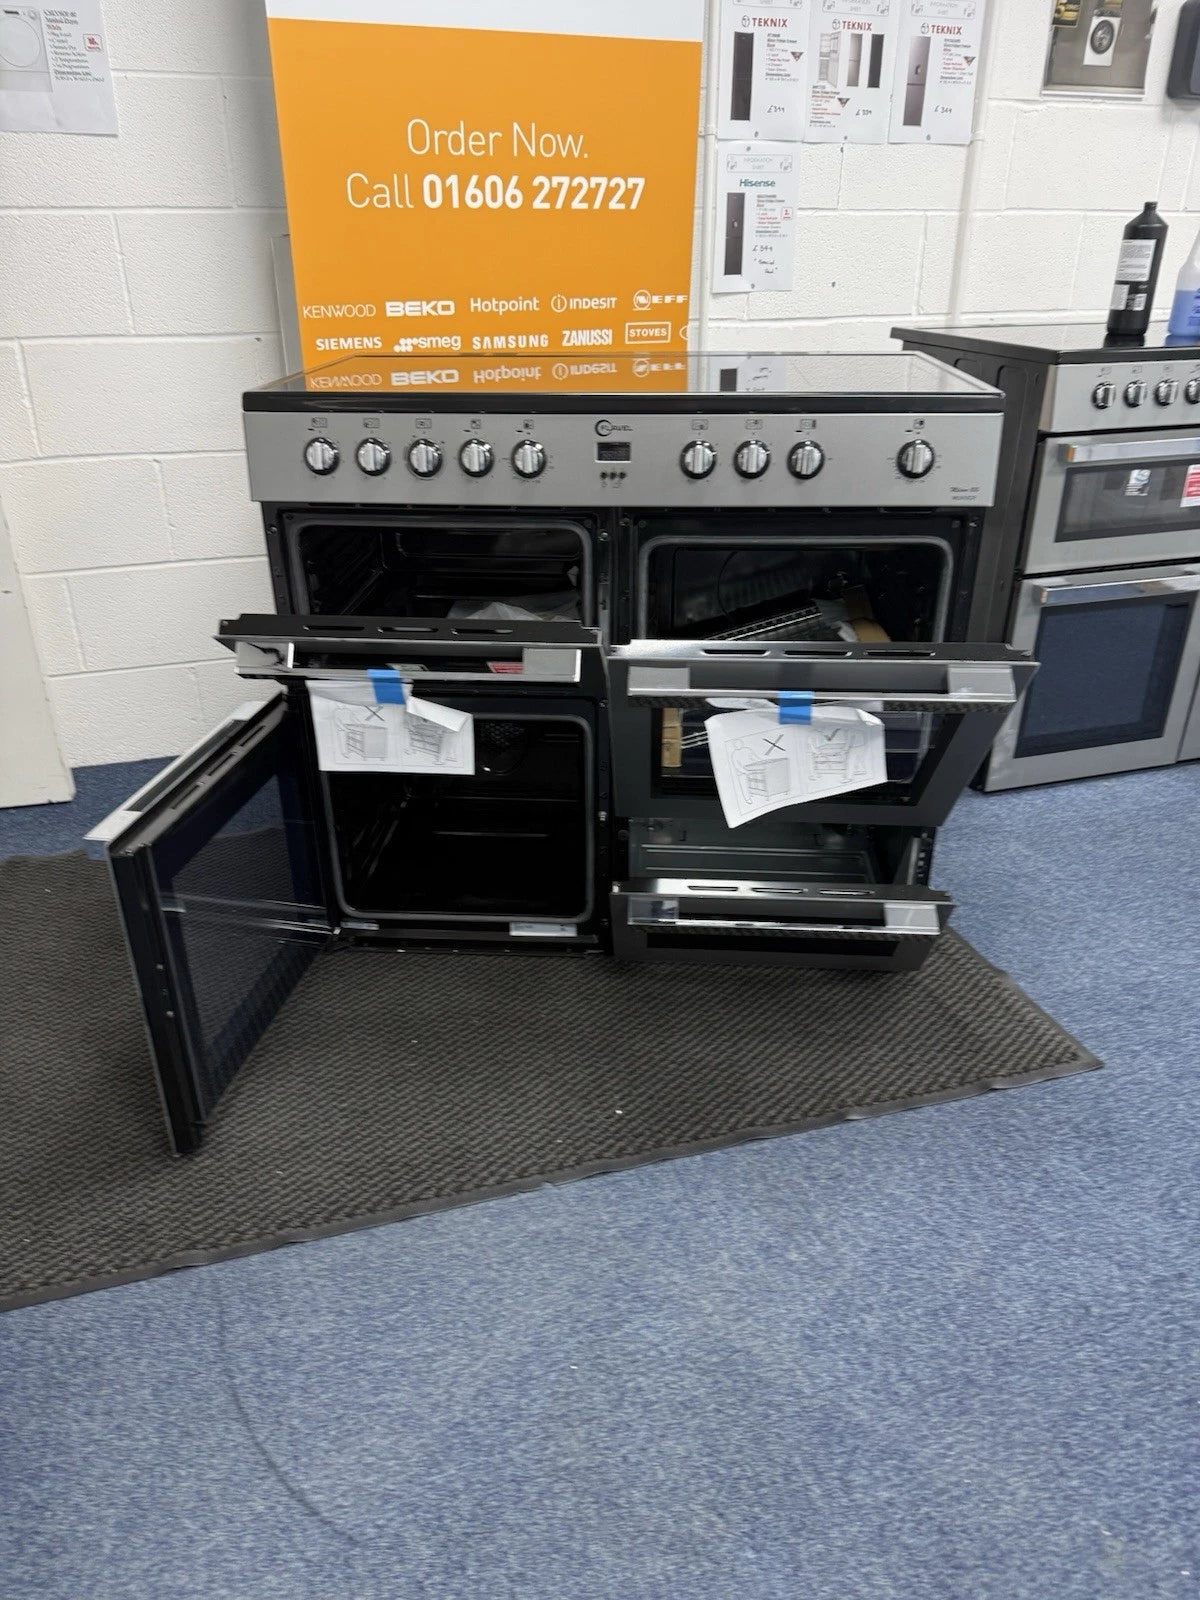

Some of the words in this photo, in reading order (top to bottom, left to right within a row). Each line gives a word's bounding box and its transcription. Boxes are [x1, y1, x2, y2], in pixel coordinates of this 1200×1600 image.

[752, 17, 788, 28] TEKNIX
[842, 20, 873, 31] TEKNIX
[931, 24, 963, 35] TEKNIX
[408, 118, 502, 156] Order
[513, 122, 588, 158] Now.
[346, 172, 414, 209] Call
[423, 174, 523, 209] 01606
[532, 176, 645, 210] 272727
[739, 178, 776, 187] Hisense
[303, 304, 376, 318] KENWOOD
[386, 301, 454, 317] BEKO
[470, 296, 539, 315] Hotpoint
[633, 291, 687, 307] NEFF
[316, 337, 381, 351] SIEMENS
[417, 336, 461, 352] smeg
[473, 334, 549, 350] SAMSUNG
[562, 329, 613, 346] ZANUSSI
[629, 327, 667, 338] STOVES
